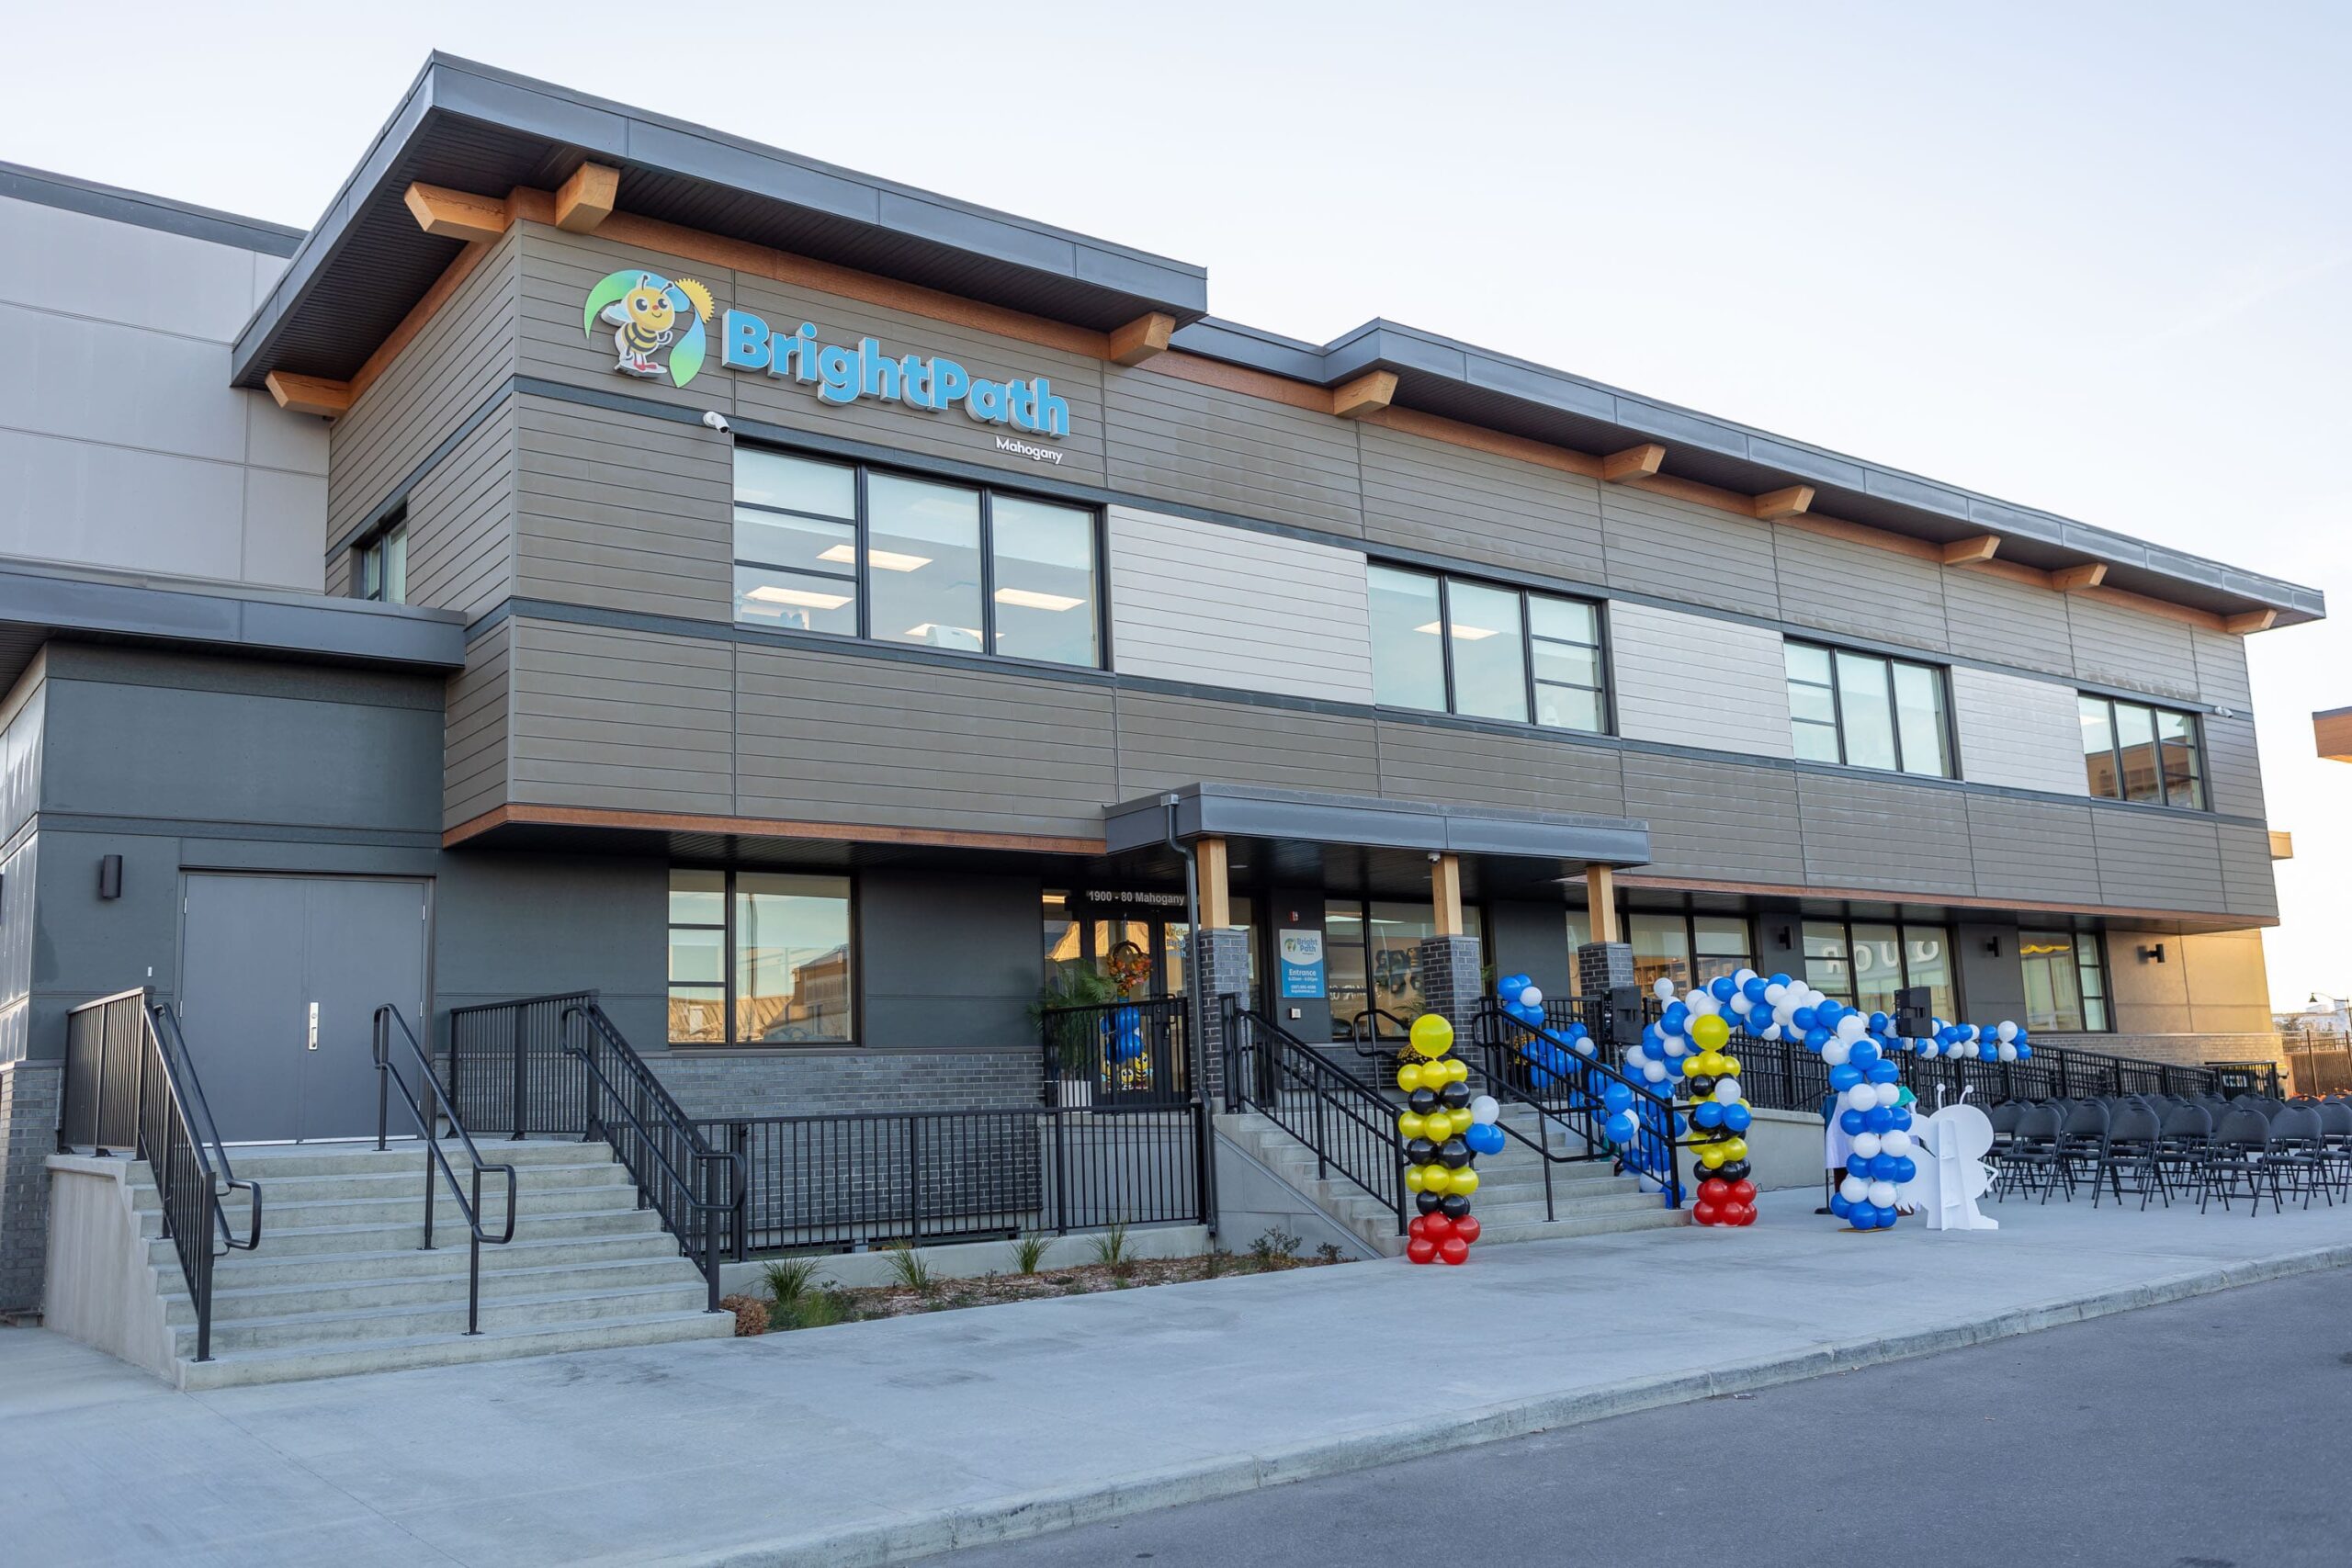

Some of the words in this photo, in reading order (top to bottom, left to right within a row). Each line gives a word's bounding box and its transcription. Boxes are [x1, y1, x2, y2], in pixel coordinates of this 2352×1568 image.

[722, 308, 1070, 439] BrightPath
[995, 435, 1063, 465] Mahogany
[1089, 891, 1113, 901] 1900
[1121, 892, 1133, 902] 80
[1135, 892, 1185, 906] Mahogany
[1296, 937, 1318, 946] Bright
[1300, 944, 1317, 953] Path
[1288, 968, 1317, 976] Entrance
